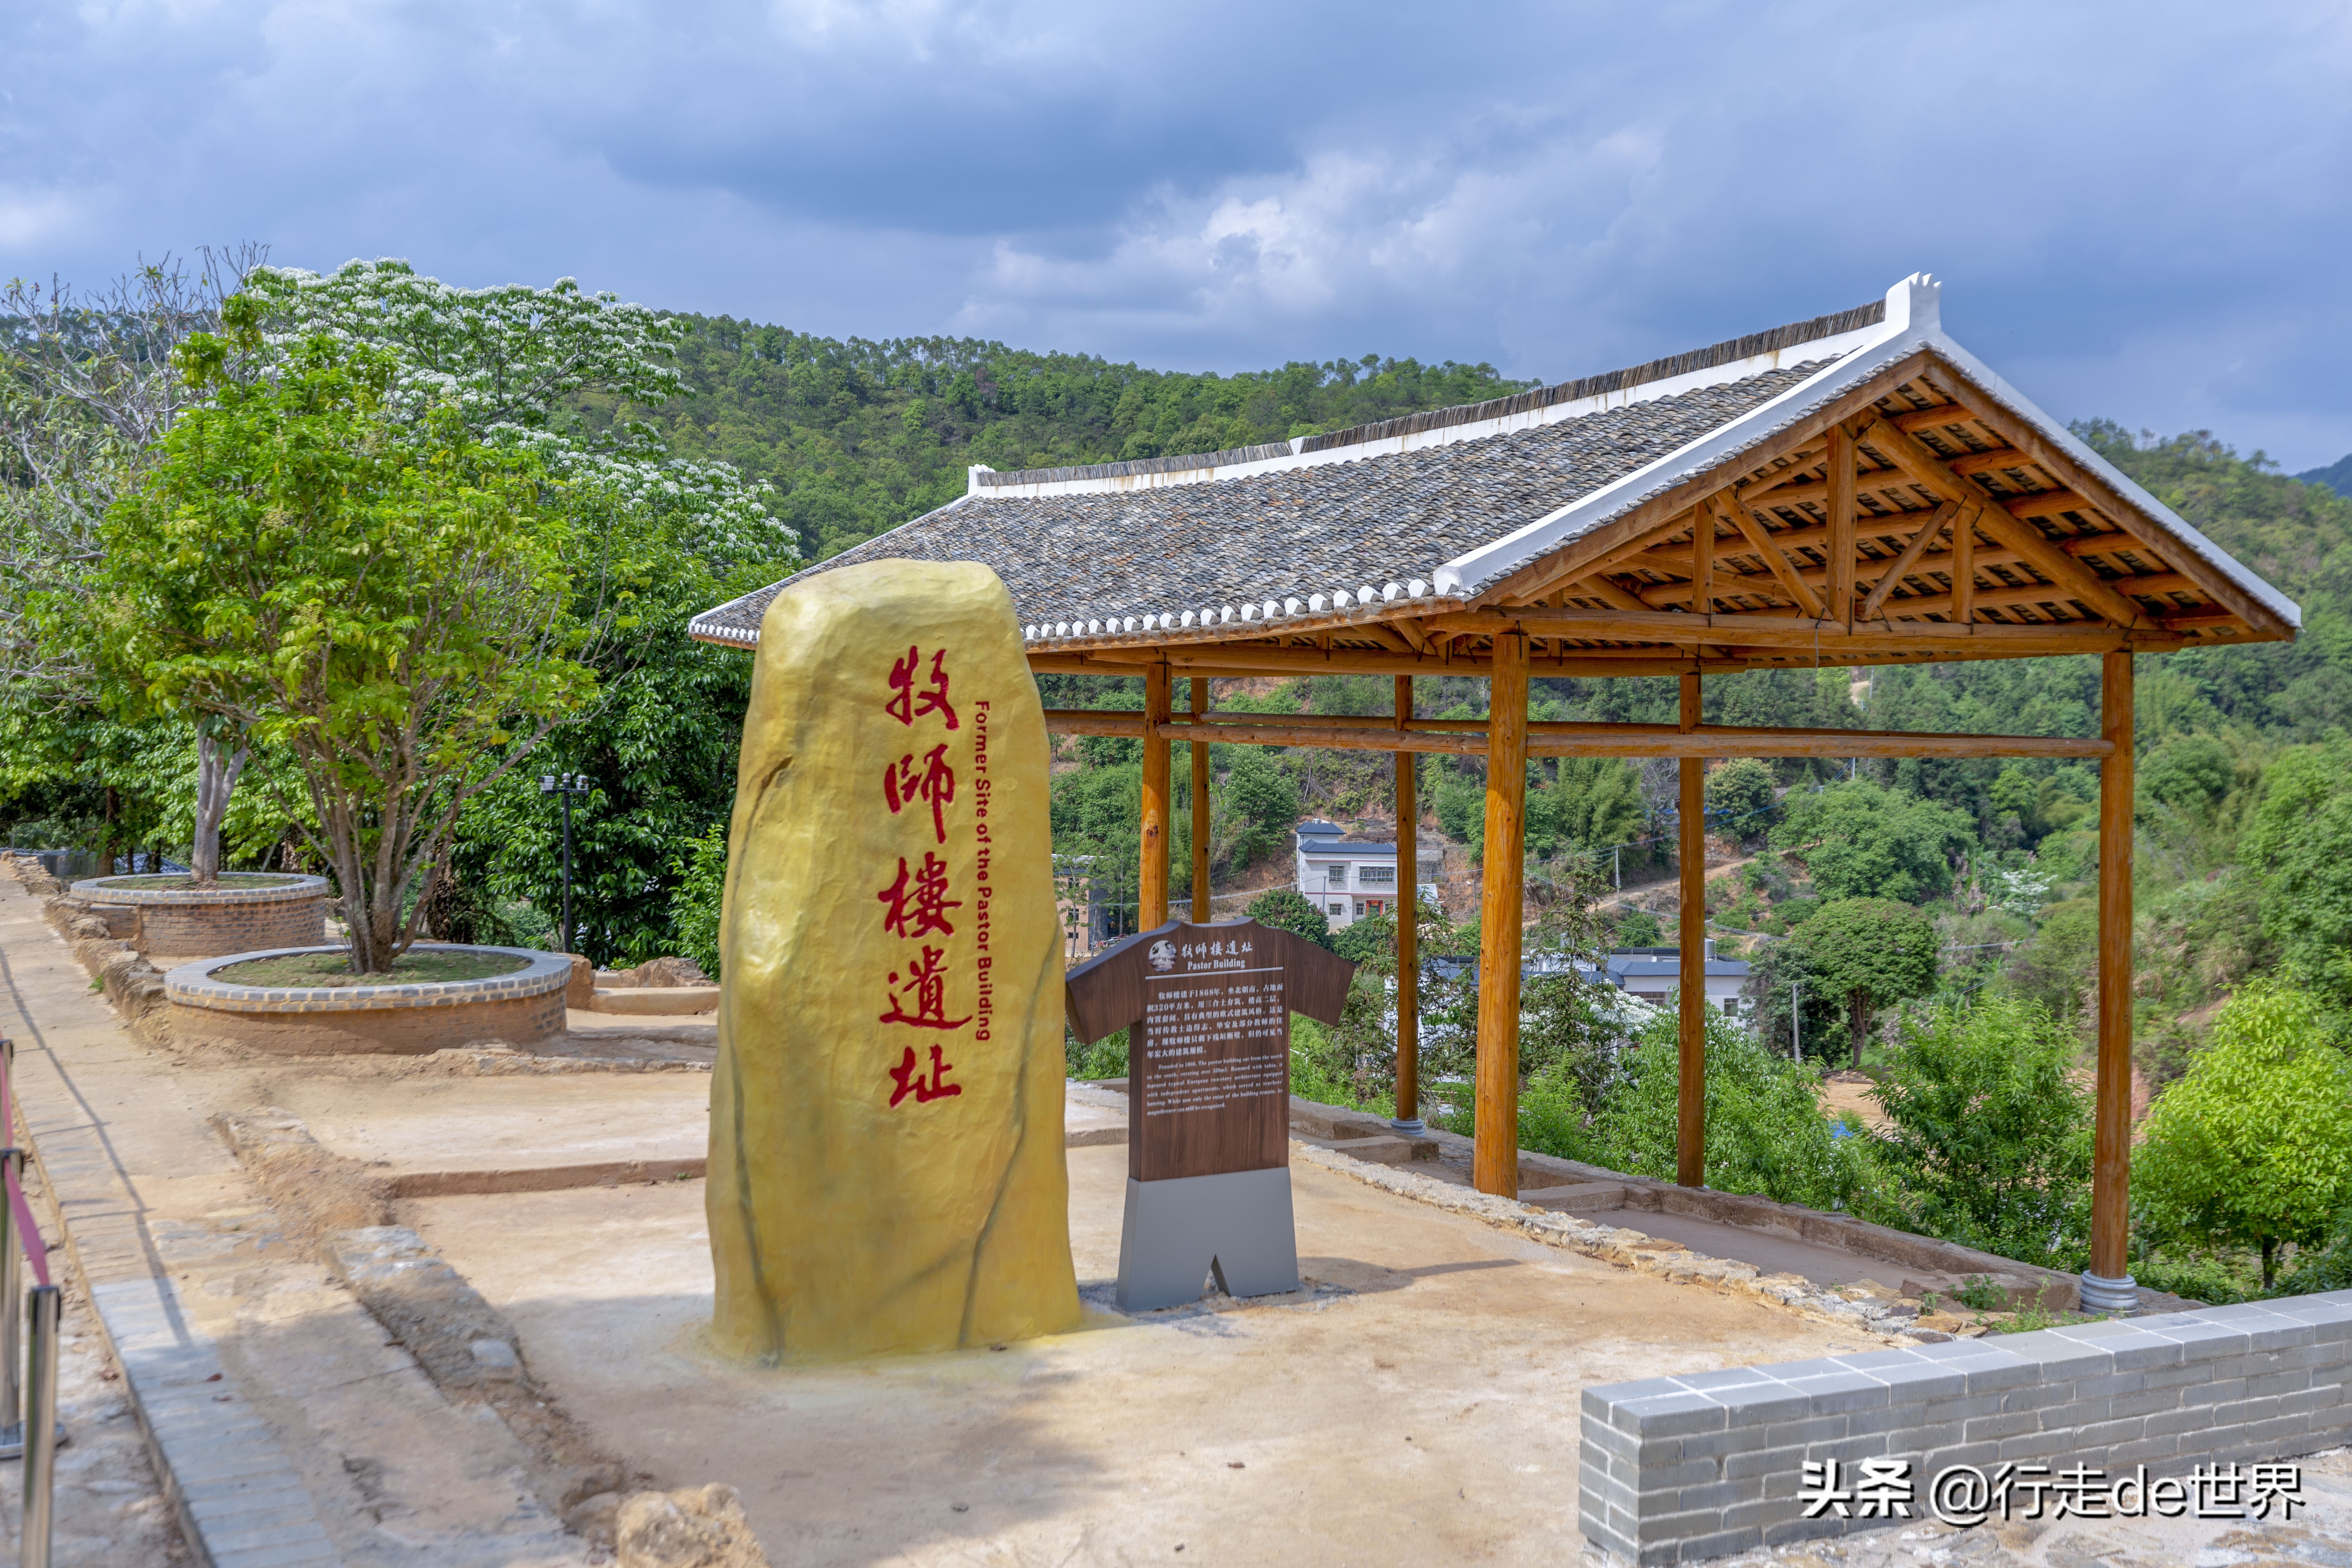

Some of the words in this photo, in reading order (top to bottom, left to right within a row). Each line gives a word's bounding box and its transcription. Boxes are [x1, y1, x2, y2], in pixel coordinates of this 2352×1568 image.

[975, 701, 989, 773] Former
[976, 778, 991, 817] Site
[976, 824, 991, 844] of
[977, 848, 990, 881] the
[978, 887, 992, 951] Pastor
[1187, 961, 1212, 971] Pastor
[1214, 958, 1245, 969] Building
[976, 957, 993, 1041] Building
[1160, 1089, 1189, 1097] independent
[1147, 1108, 1176, 1116] magnificence
